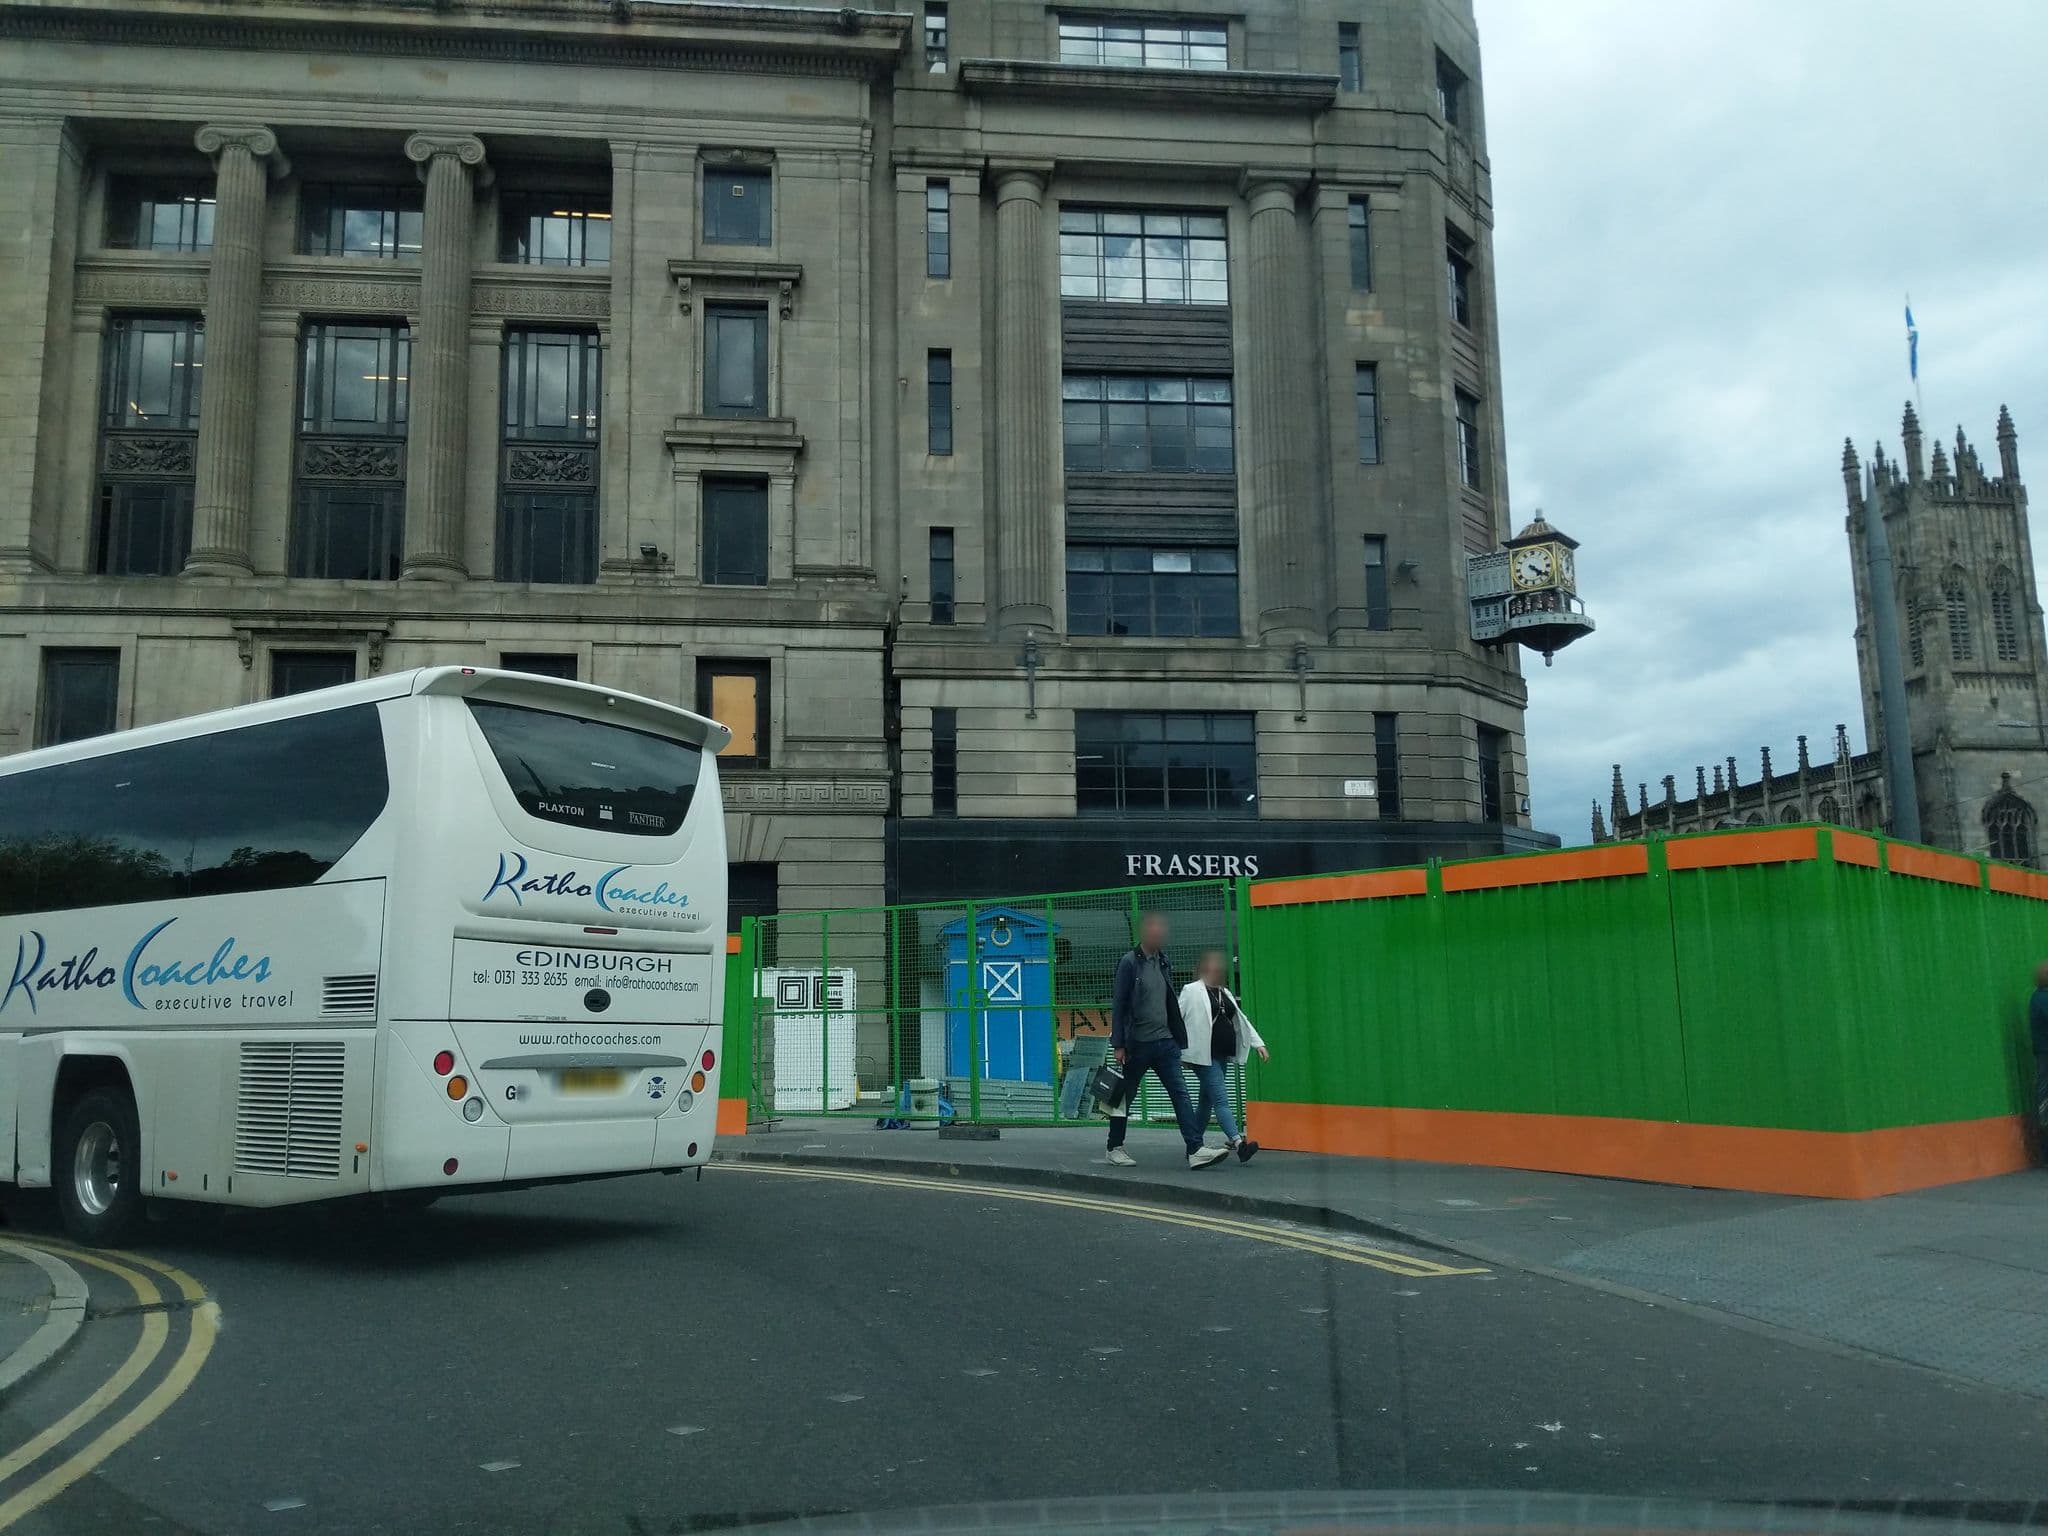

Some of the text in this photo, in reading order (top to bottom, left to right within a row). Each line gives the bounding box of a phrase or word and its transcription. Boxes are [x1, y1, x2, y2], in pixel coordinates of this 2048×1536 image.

[538, 802, 585, 816] PLAXTON
[628, 811, 666, 828] PANTHER
[1125, 854, 1259, 876] FRASERS
[482, 851, 690, 912] Ratho Coaches
[619, 905, 700, 921] executive travel
[0, 916, 272, 1015] Ratho Coaches
[516, 950, 672, 973] EDINBURGH
[473, 969, 699, 992] tel: 0131 333 2635 email: info@rathocoaches.com
[155, 990, 294, 1010] executive travel
[519, 1031, 662, 1045] www.rathocoaches.com
